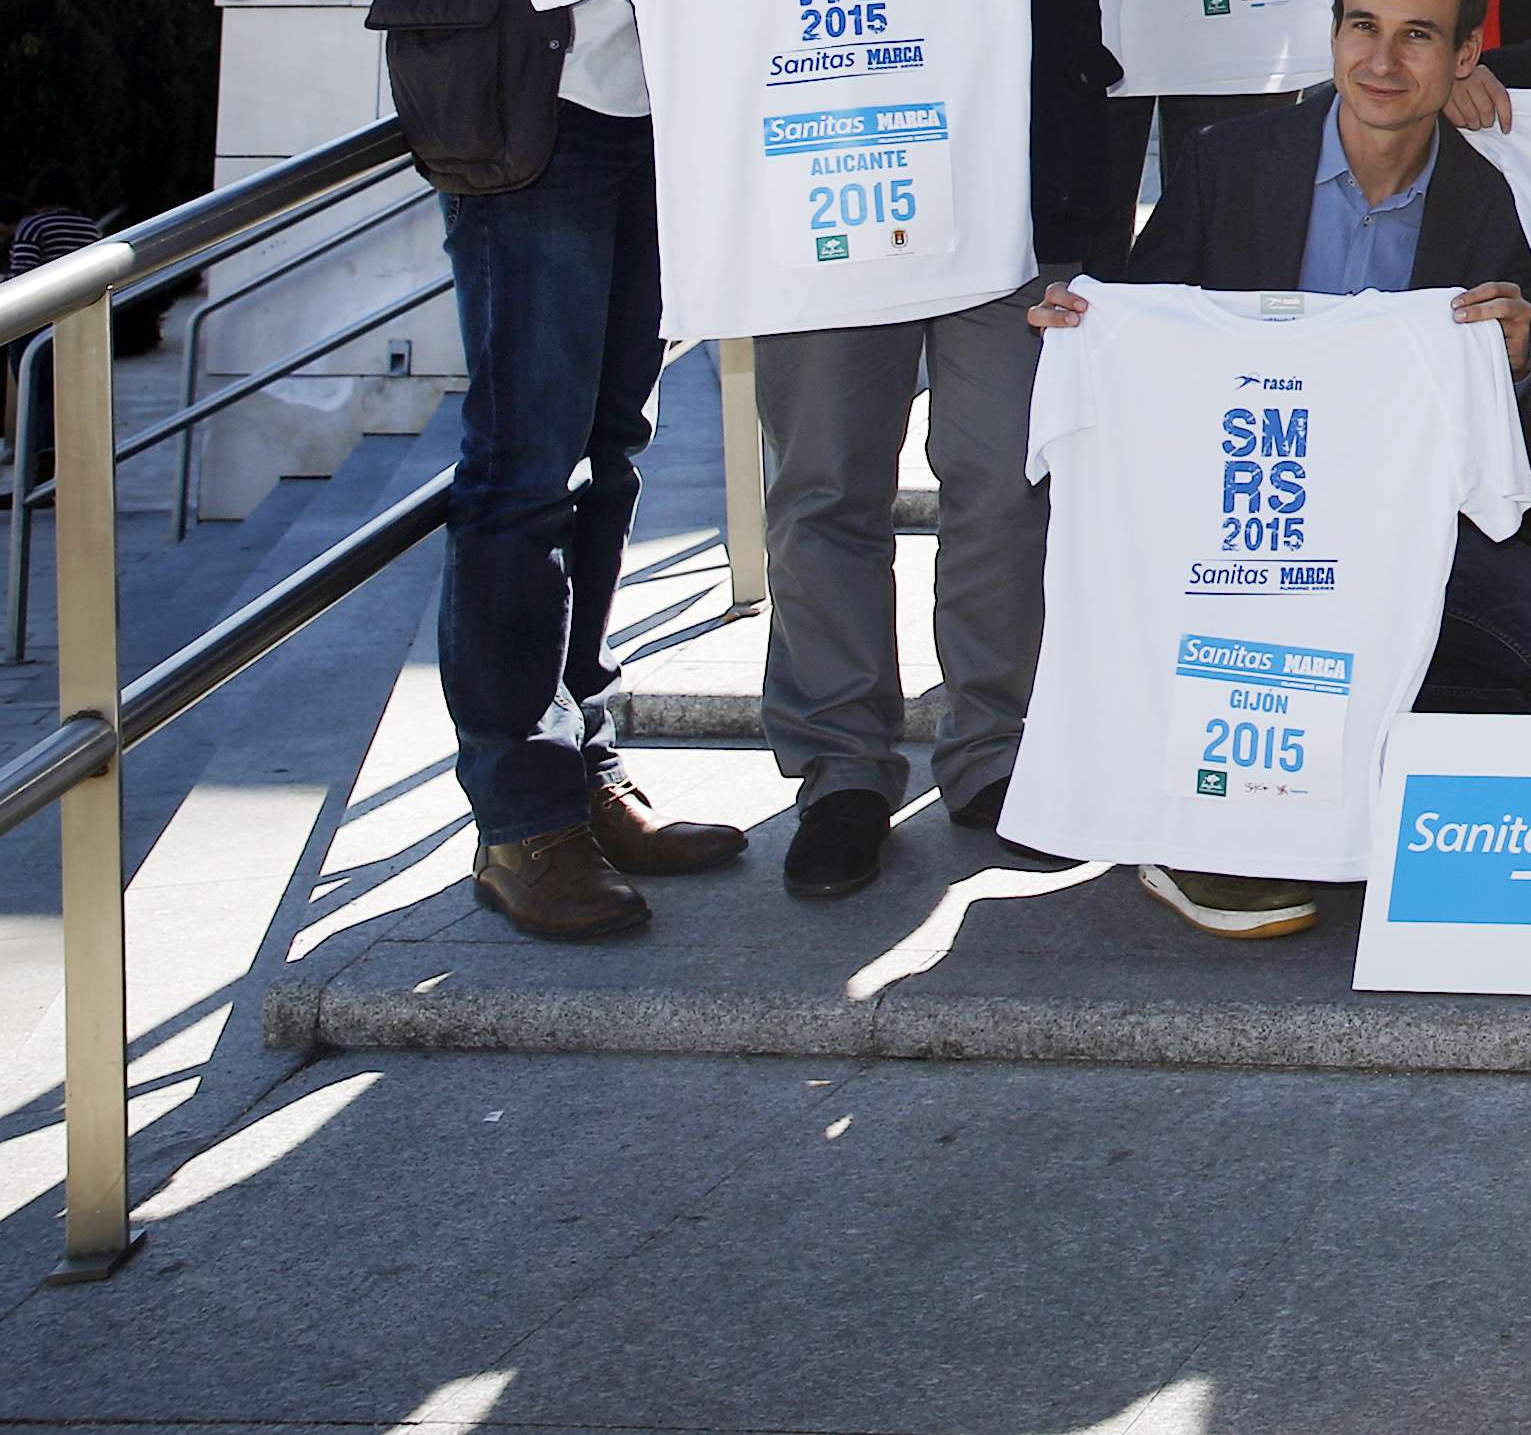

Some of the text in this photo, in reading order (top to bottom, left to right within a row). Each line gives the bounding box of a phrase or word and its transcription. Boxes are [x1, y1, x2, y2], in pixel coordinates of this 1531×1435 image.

[800, 3, 888, 41] 2015
[770, 45, 924, 76] Sanitas MARCA
[769, 115, 865, 143] Sanitas
[876, 109, 941, 131] MARCA
[810, 150, 908, 176] ALICANTE
[808, 178, 916, 230] 2015
[1263, 375, 1303, 391] rasán
[1221, 408, 1309, 458] SM
[1222, 460, 1307, 514] RS
[1221, 517, 1305, 552] 2015
[1189, 563, 1336, 585] Sanitas MARCA
[1183, 638, 1346, 680] Sanitas MARCA
[1230, 688, 1289, 715] GIJÓN
[1202, 718, 1306, 773] 2015
